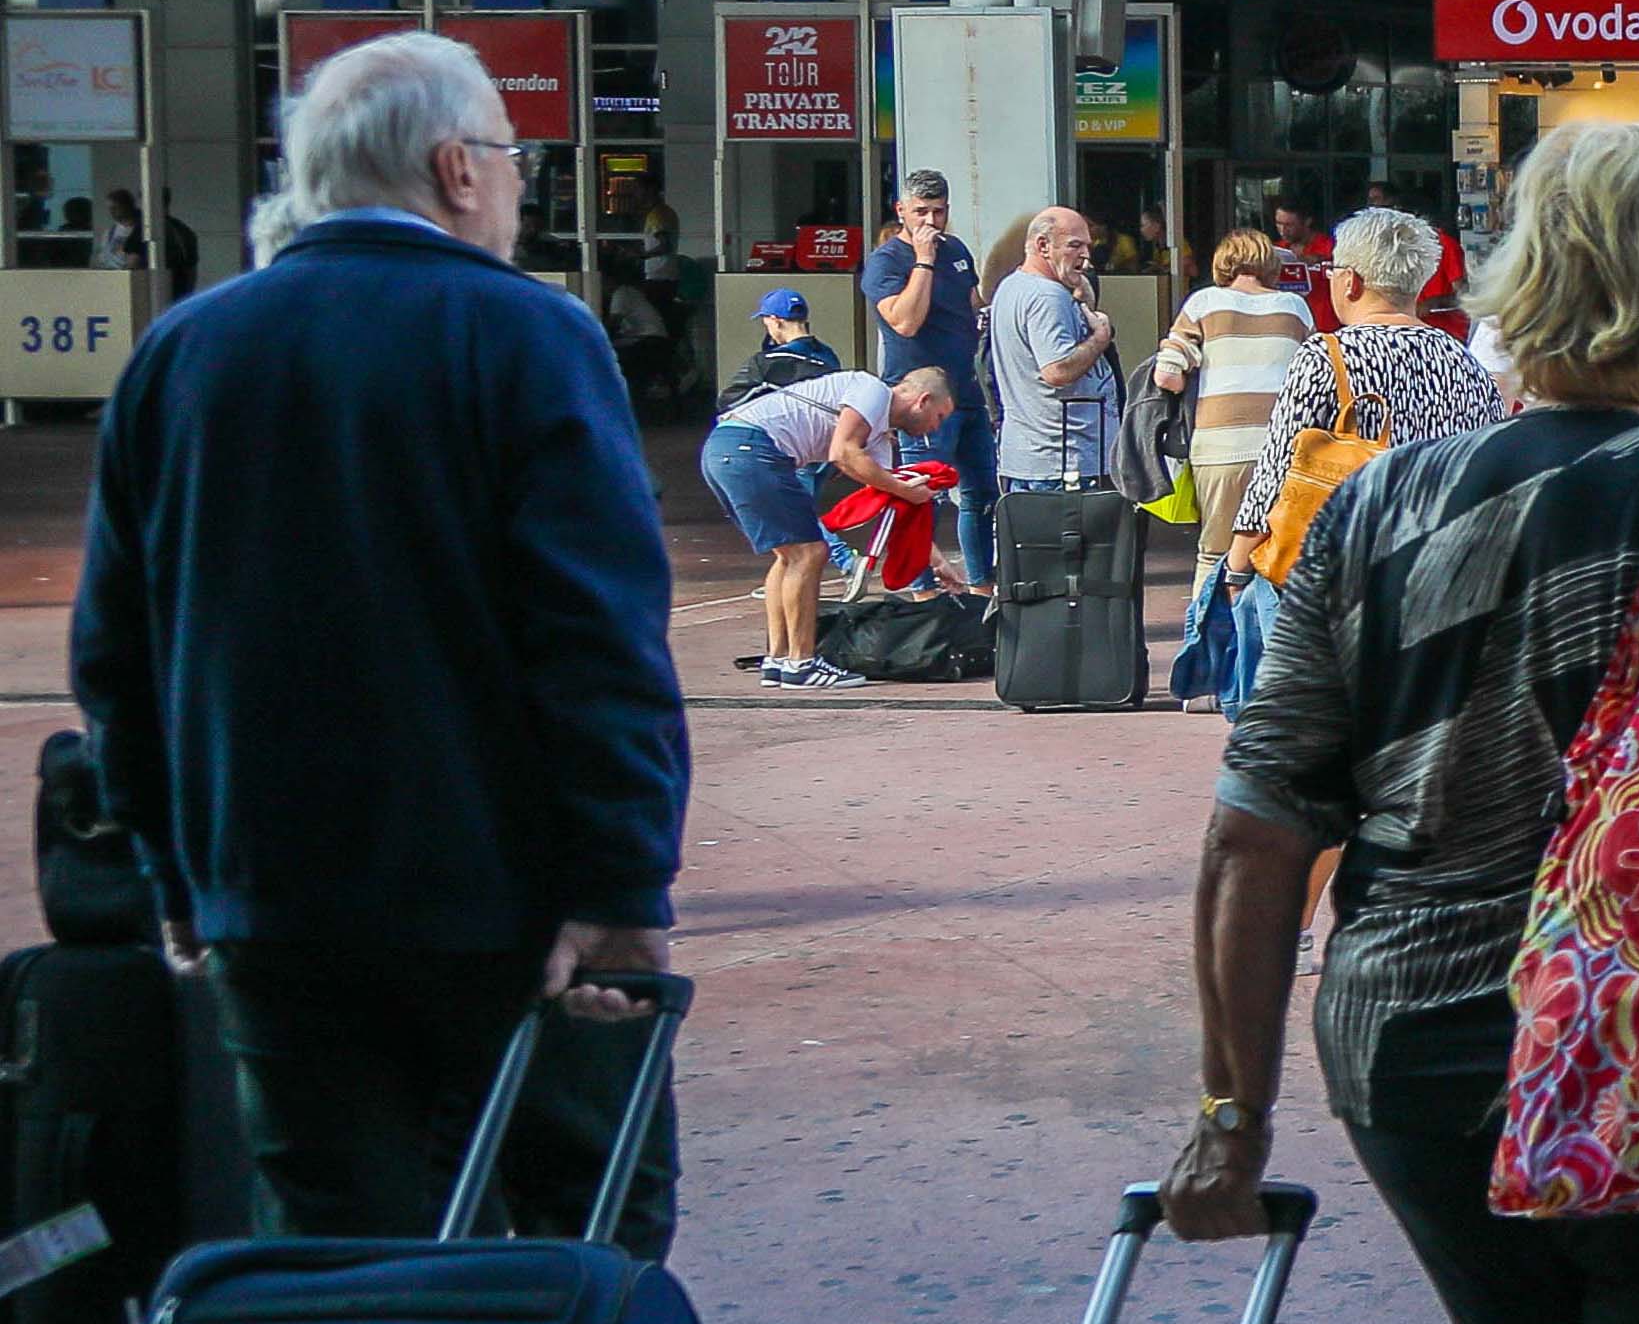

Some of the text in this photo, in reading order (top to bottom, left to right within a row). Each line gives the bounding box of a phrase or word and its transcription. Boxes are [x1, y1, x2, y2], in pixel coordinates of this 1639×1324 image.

[765, 26, 818, 55] 242
[765, 58, 818, 88] TOUR
[744, 92, 840, 109] PRIVATE
[733, 113, 852, 130] TRANSFER
[1103, 119, 1127, 132] VIP
[814, 229, 848, 243] 242
[815, 244, 845, 255] TOUR
[21, 316, 110, 354] 38F
